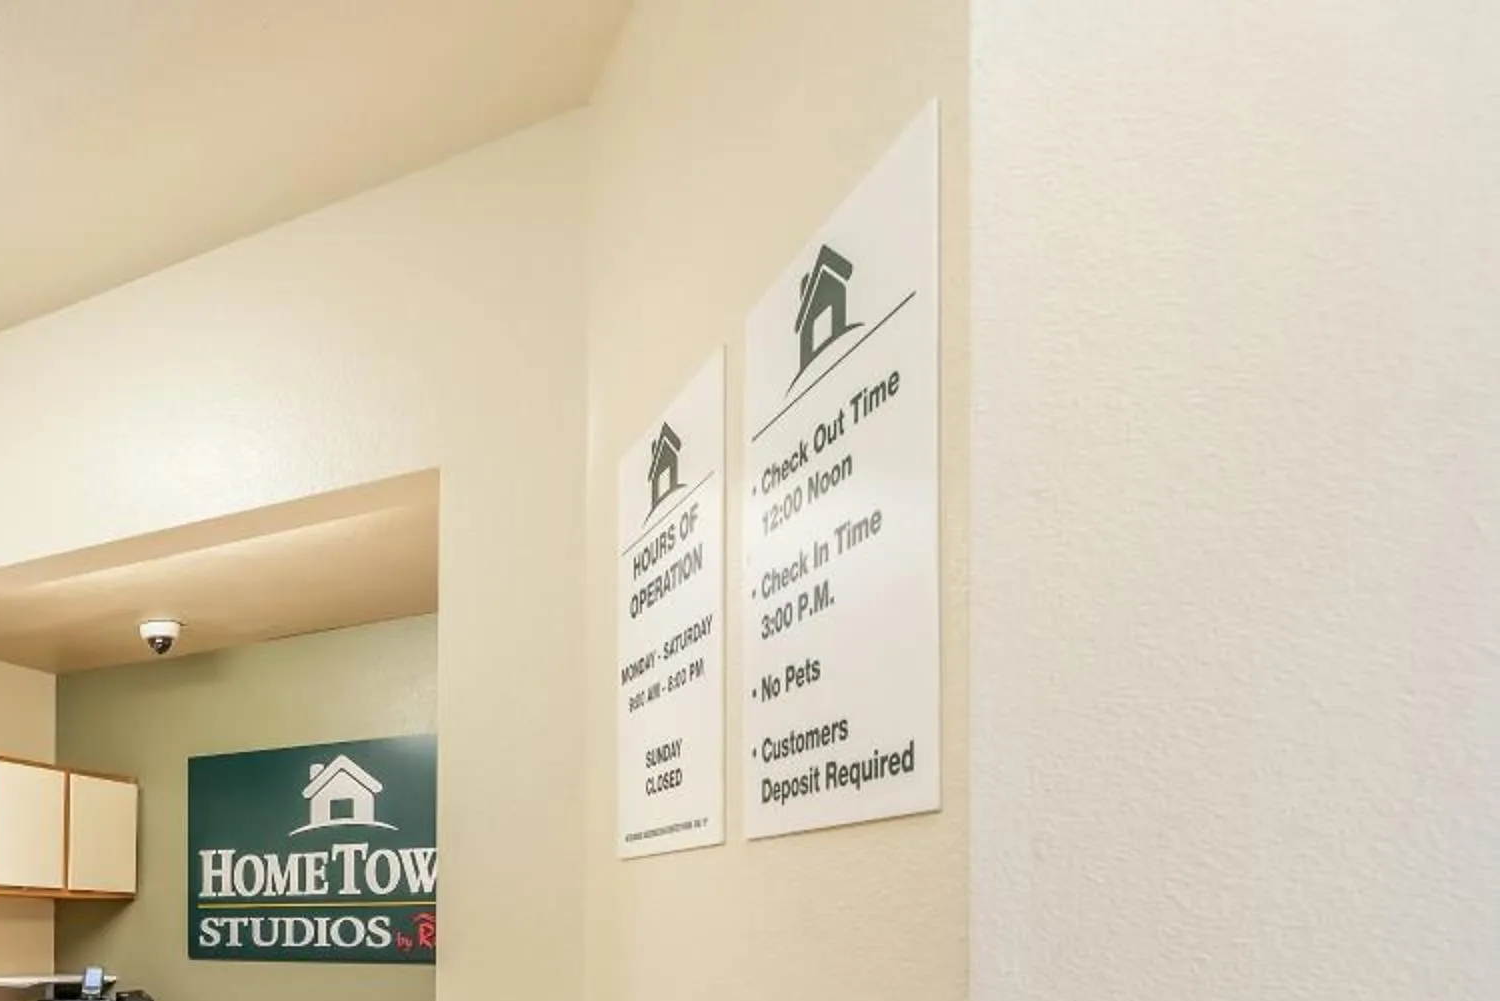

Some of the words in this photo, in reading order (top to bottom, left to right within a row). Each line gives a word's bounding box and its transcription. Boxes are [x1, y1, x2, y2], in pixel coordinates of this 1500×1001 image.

[761, 439, 809, 495] Check
[813, 408, 845, 454] Out
[850, 370, 900, 425] Time
[761, 485, 803, 537] 12:00
[807, 453, 853, 504] Noon
[632, 523, 676, 581] HOURS
[679, 502, 699, 541] OF
[761, 549, 809, 600] Check
[813, 540, 829, 569] In
[834, 509, 882, 555] Time
[630, 543, 703, 619] OPERATION
[761, 602, 793, 640] 3:00
[798, 579, 835, 622] P.M.
[621, 650, 656, 686] MONDAY
[663, 613, 712, 660] SATURDAY
[689, 657, 704, 682] PM
[761, 674, 781, 702] No
[785, 658, 821, 692] Pets
[645, 738, 683, 768] SUNDAY
[761, 718, 849, 763] Customers
[645, 767, 683, 796] CLOSED
[761, 766, 820, 806] Deposit
[825, 739, 915, 791] Required
[198, 842, 437, 898] HOMETOW
[199, 915, 391, 949] STUDIOS
